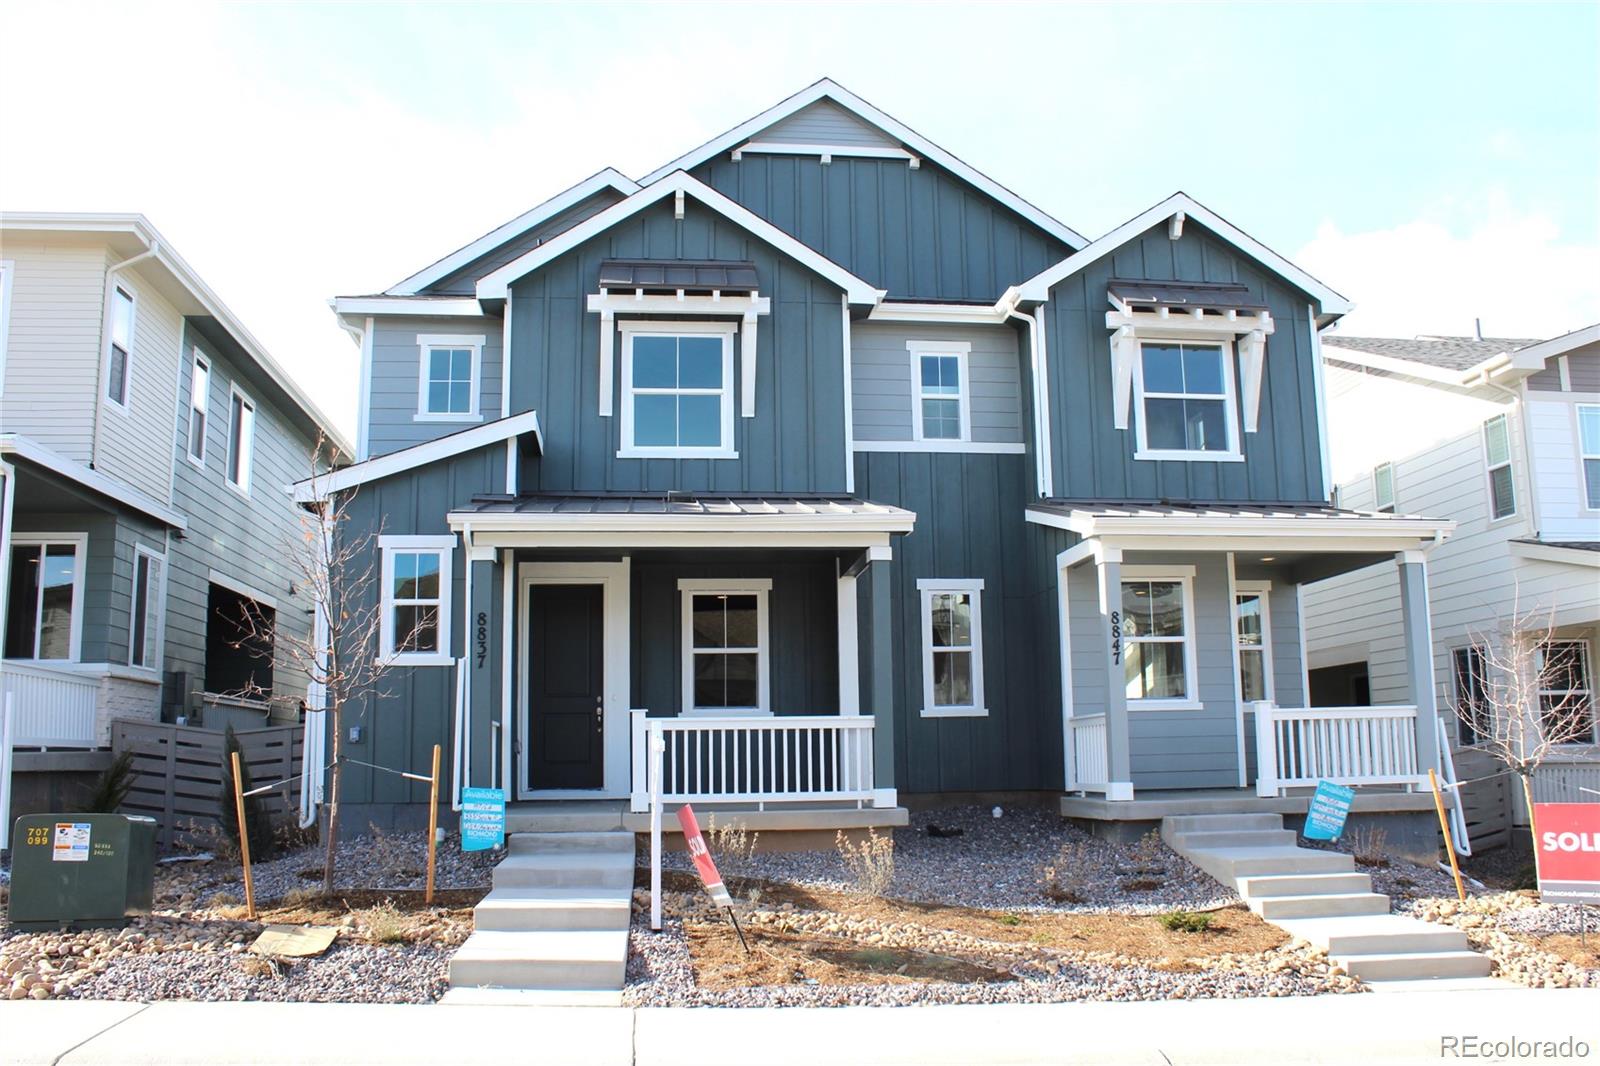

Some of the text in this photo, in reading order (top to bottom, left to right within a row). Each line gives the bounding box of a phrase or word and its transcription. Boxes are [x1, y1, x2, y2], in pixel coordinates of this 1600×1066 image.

[477, 611, 487, 669] 8837
[1111, 611, 1121, 665] 8847
[27, 837, 48, 845] 099
[28, 828, 49, 836] 707
